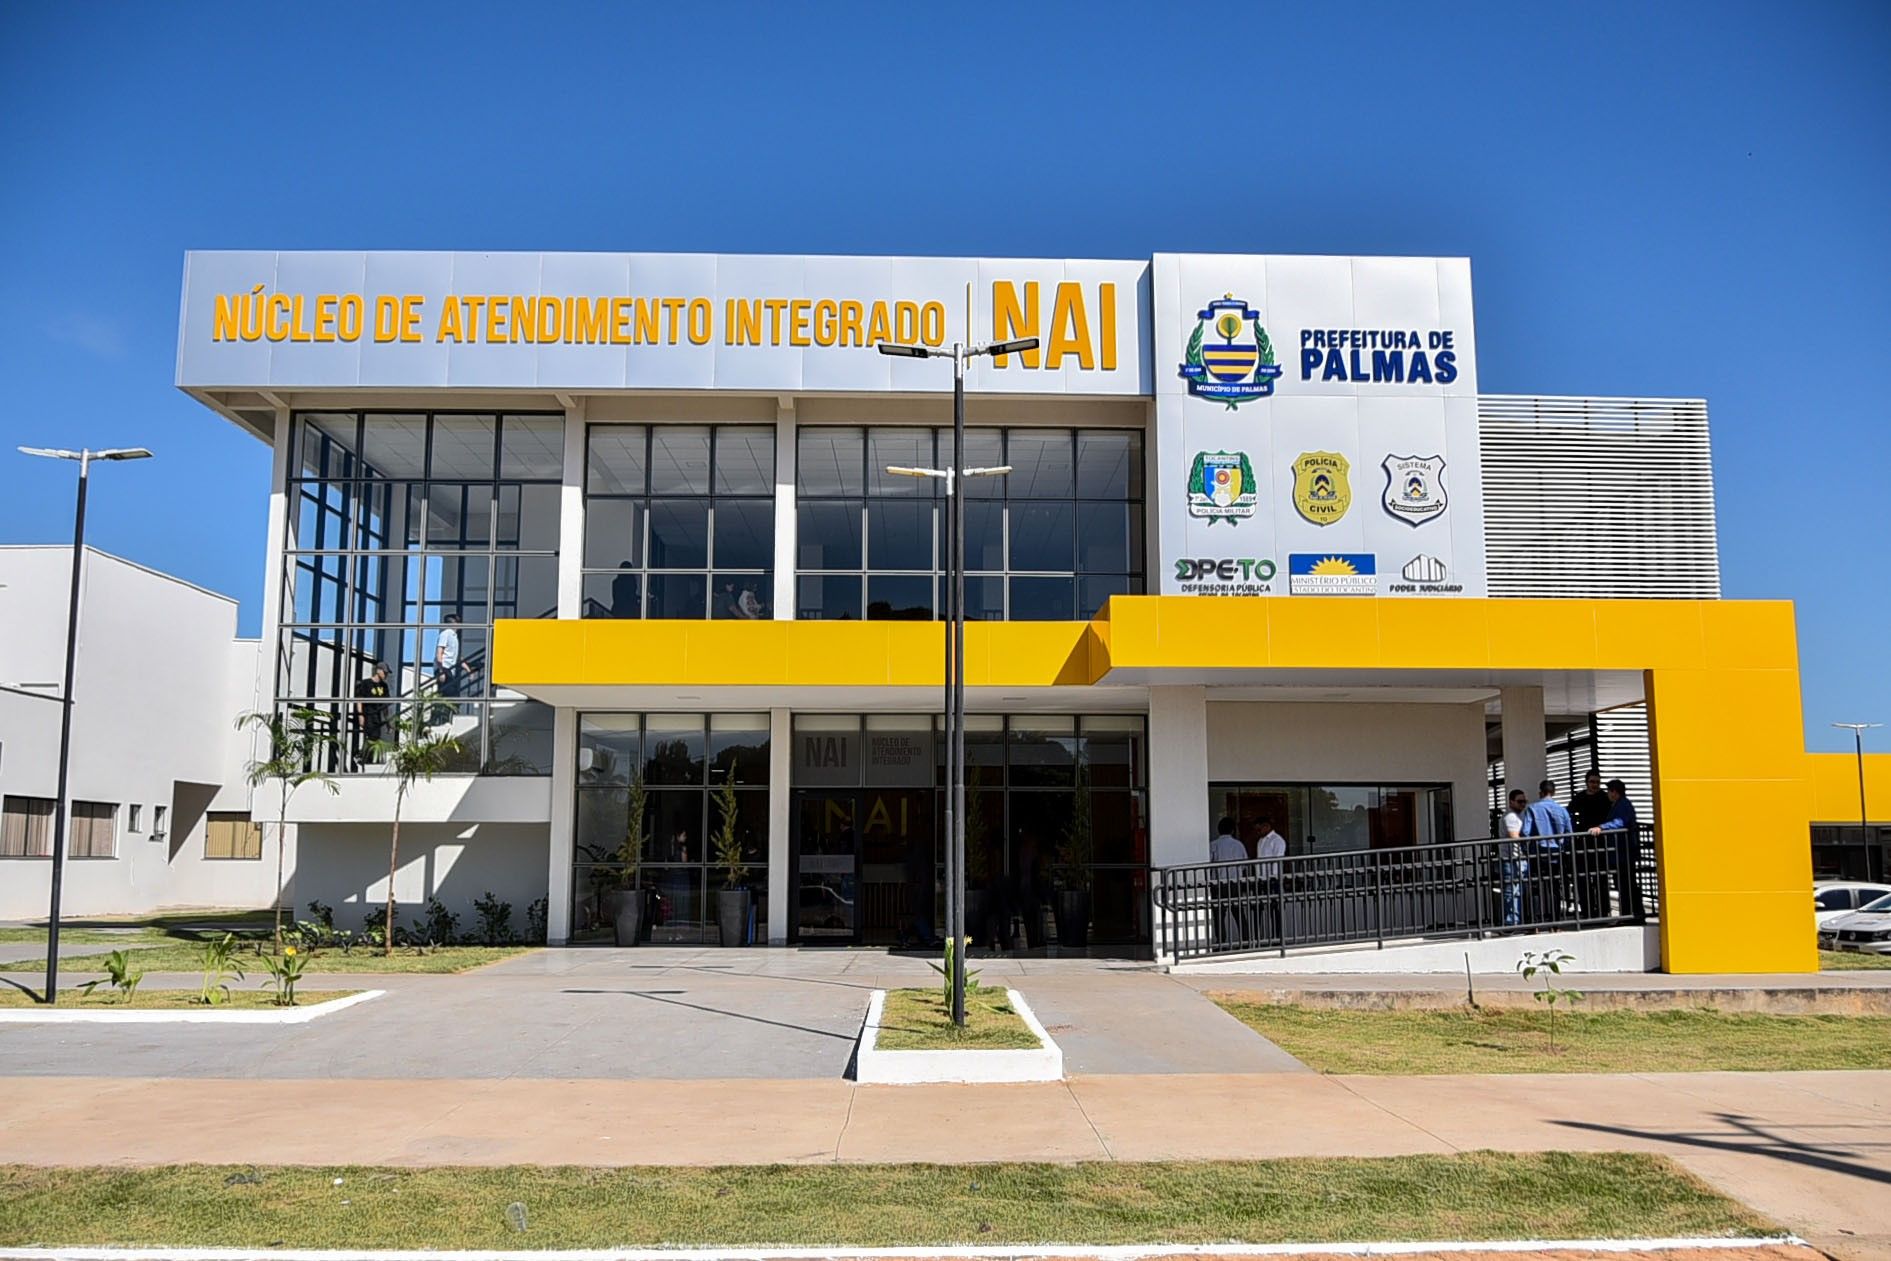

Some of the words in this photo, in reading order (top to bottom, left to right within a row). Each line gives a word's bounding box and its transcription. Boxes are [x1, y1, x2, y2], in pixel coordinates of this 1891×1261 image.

[212, 283, 363, 343] NÚCLEO
[374, 295, 424, 343] DE
[437, 296, 712, 345] ATENDIMENTO
[724, 297, 945, 347] INTEGRADO
[992, 280, 1117, 370] NAI
[1300, 329, 1421, 349] PREFEITURA
[1428, 331, 1454, 349] DE
[1300, 350, 1458, 384] PALMAS
[1196, 384, 1231, 393] MUNICÍPIO
[1232, 385, 1240, 393] DE
[1241, 385, 1268, 393] PALMAS
[1304, 458, 1338, 468] POLÍCIA
[1397, 462, 1432, 471] SISTEMA
[1309, 504, 1337, 513] CIVIL
[1291, 576, 1340, 585] MINISTÉRIO
[1341, 576, 1377, 585] PÚBLICO
[1181, 584, 1235, 593] DEFENSORIA
[1236, 582, 1271, 593] PÚBLICA
[1389, 584, 1416, 593] PODER
[1419, 582, 1464, 593] JUDICIÁRIO
[805, 737, 847, 768] NAI
[825, 796, 907, 834] NAI
